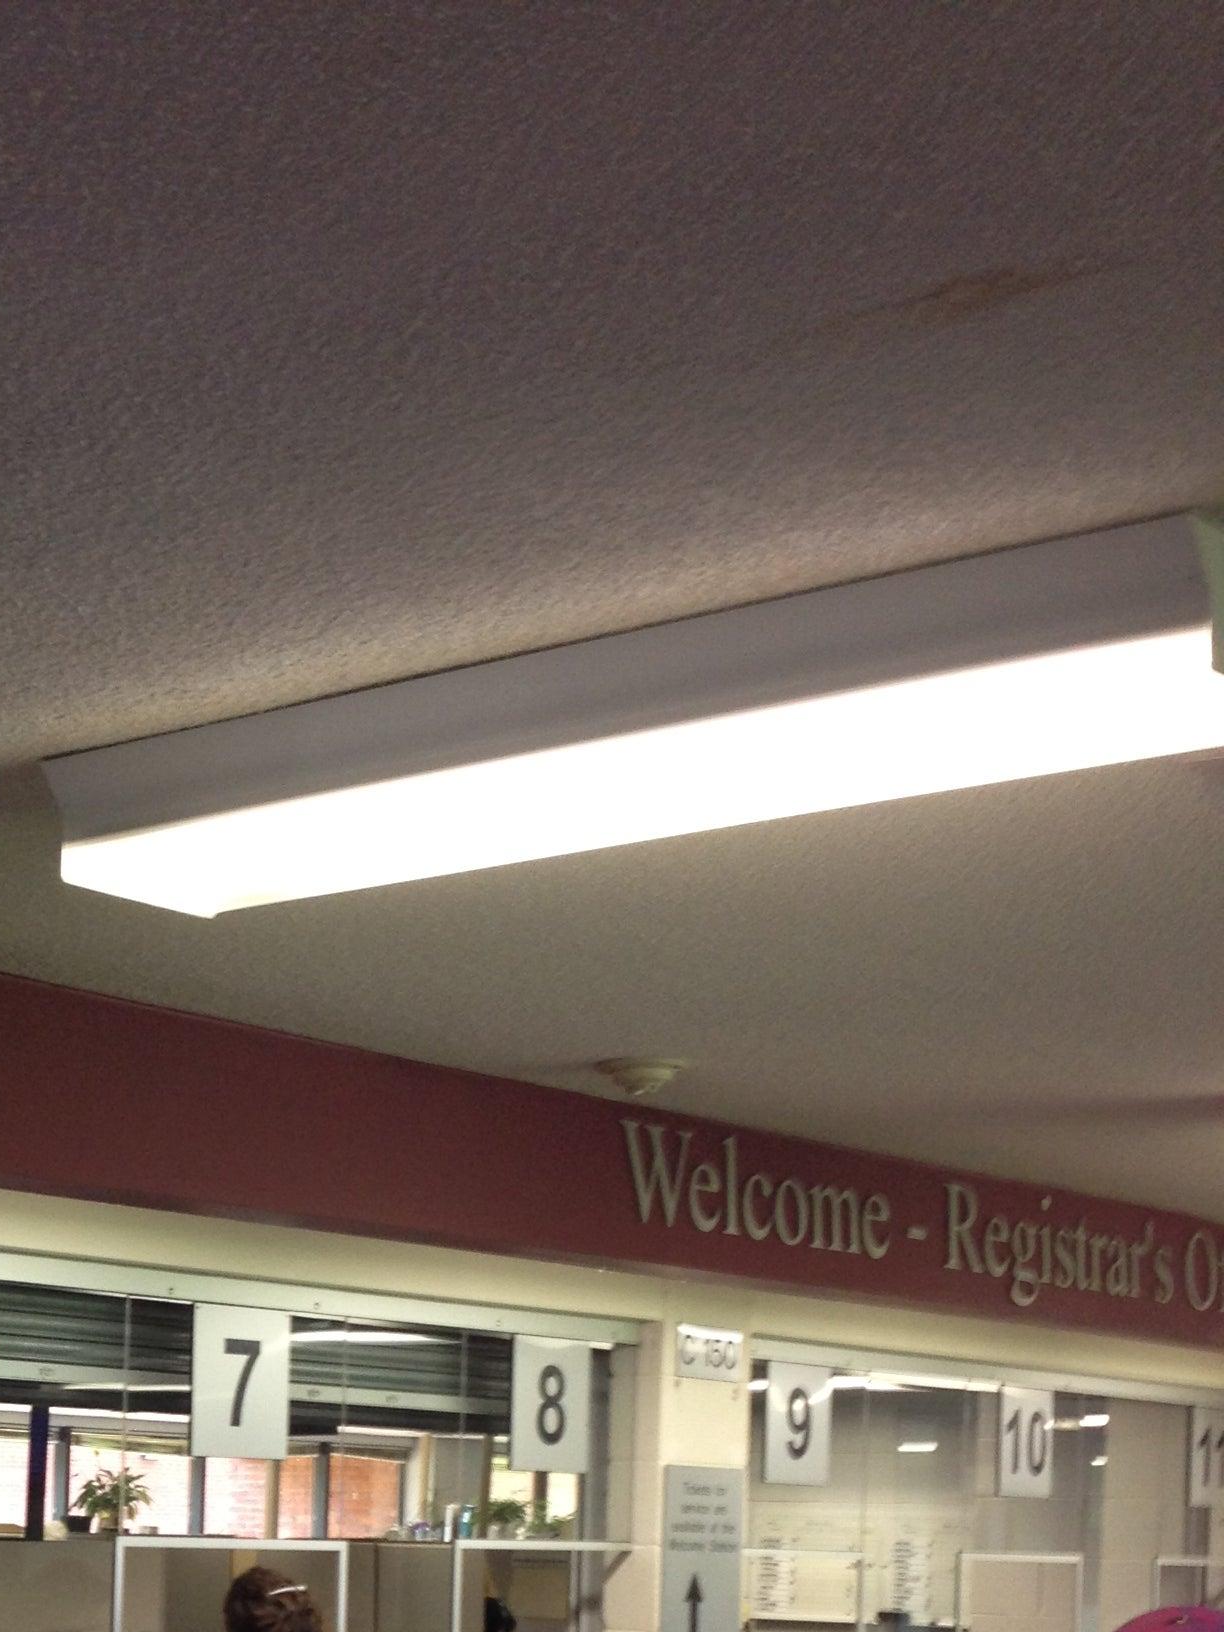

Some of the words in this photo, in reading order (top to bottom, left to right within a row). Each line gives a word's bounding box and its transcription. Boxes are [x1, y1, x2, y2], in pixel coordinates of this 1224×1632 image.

[620, 1119, 891, 1260] Welcome
[943, 1182, 1174, 1307] Registrar's
[1184, 1230, 1224, 1312] O
[223, 1337, 262, 1427] 7
[538, 1364, 566, 1446] 8
[786, 1387, 813, 1460] 9
[1006, 1408, 1047, 1477] 10
